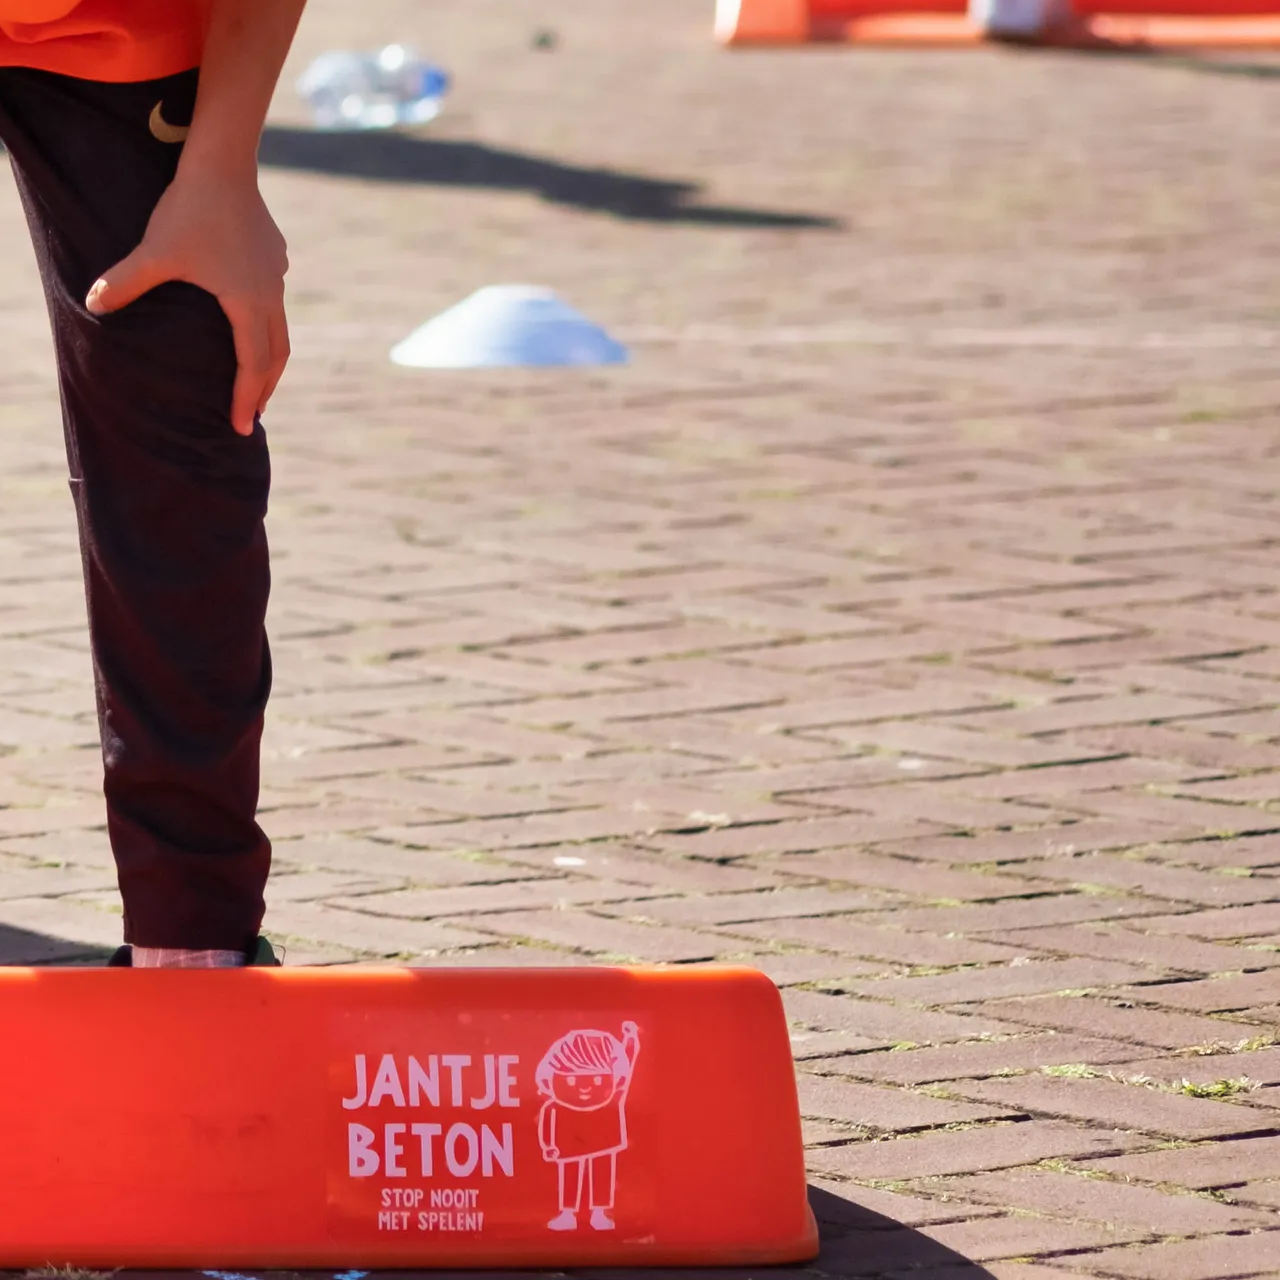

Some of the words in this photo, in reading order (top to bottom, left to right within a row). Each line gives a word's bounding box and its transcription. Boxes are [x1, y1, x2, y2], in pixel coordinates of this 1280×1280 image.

[342, 1054, 520, 1110] JANTJE
[348, 1122, 515, 1178] BETON
[381, 1188, 423, 1208] STOP
[431, 1189, 479, 1208] NOOIT
[378, 1211, 410, 1230] MET
[417, 1211, 483, 1231] SPELEN!
